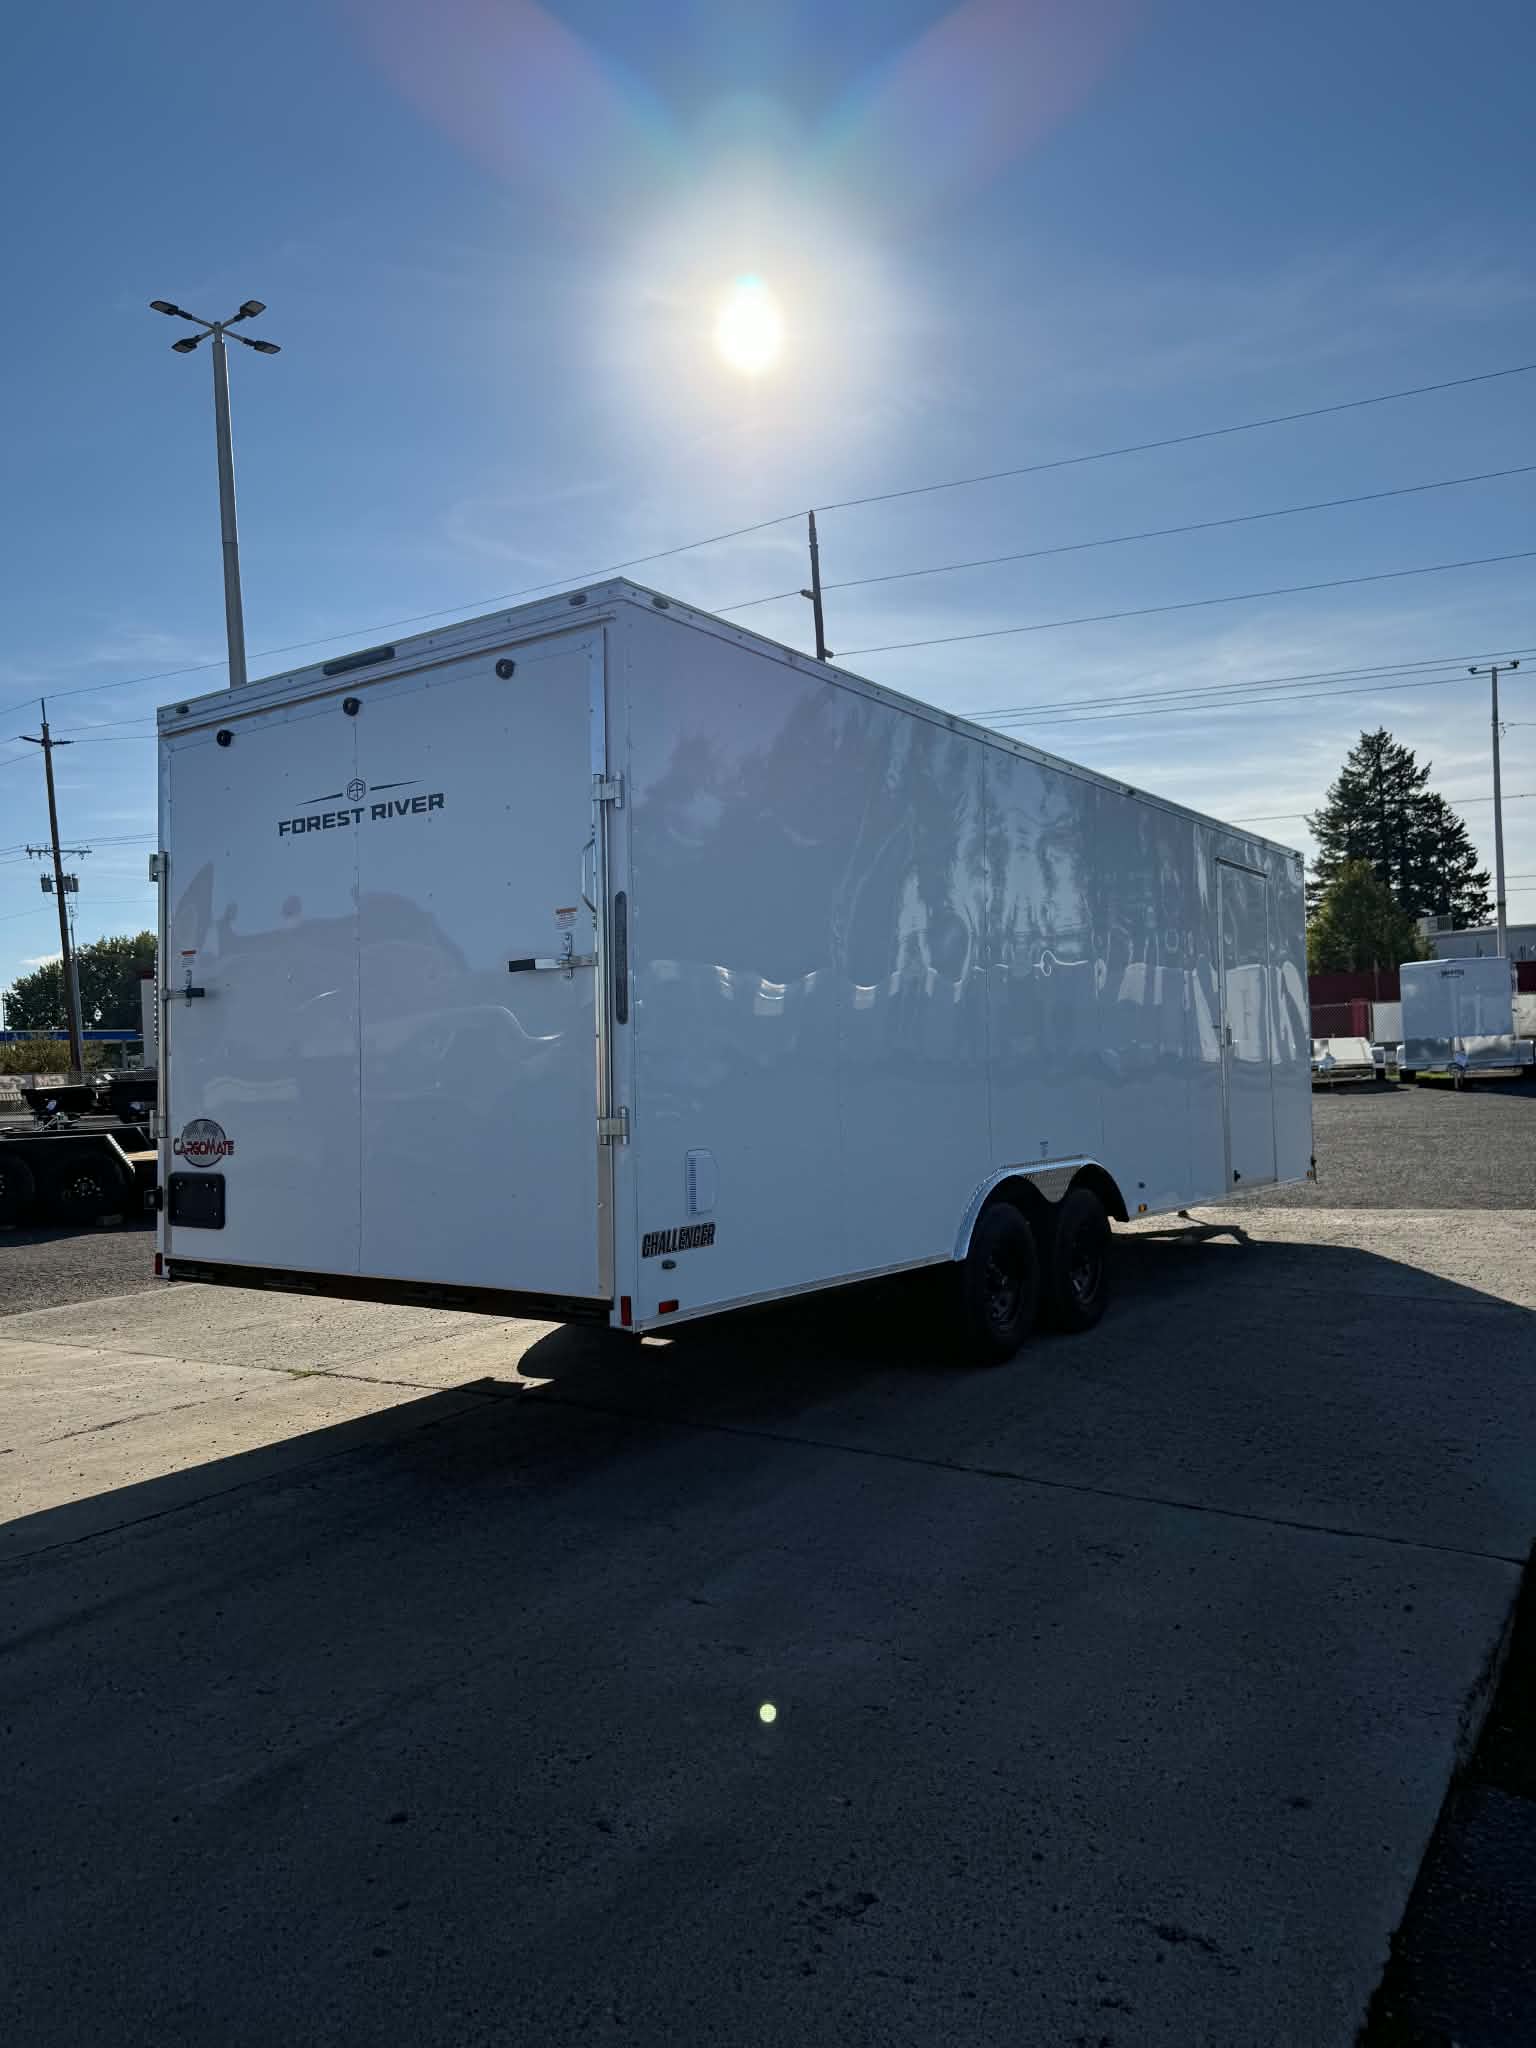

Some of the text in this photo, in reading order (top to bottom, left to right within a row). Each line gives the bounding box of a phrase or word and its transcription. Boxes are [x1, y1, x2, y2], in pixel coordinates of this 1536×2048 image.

[279, 793, 445, 836] FOREST RIVER
[641, 1222, 716, 1257] CHALLENGER
